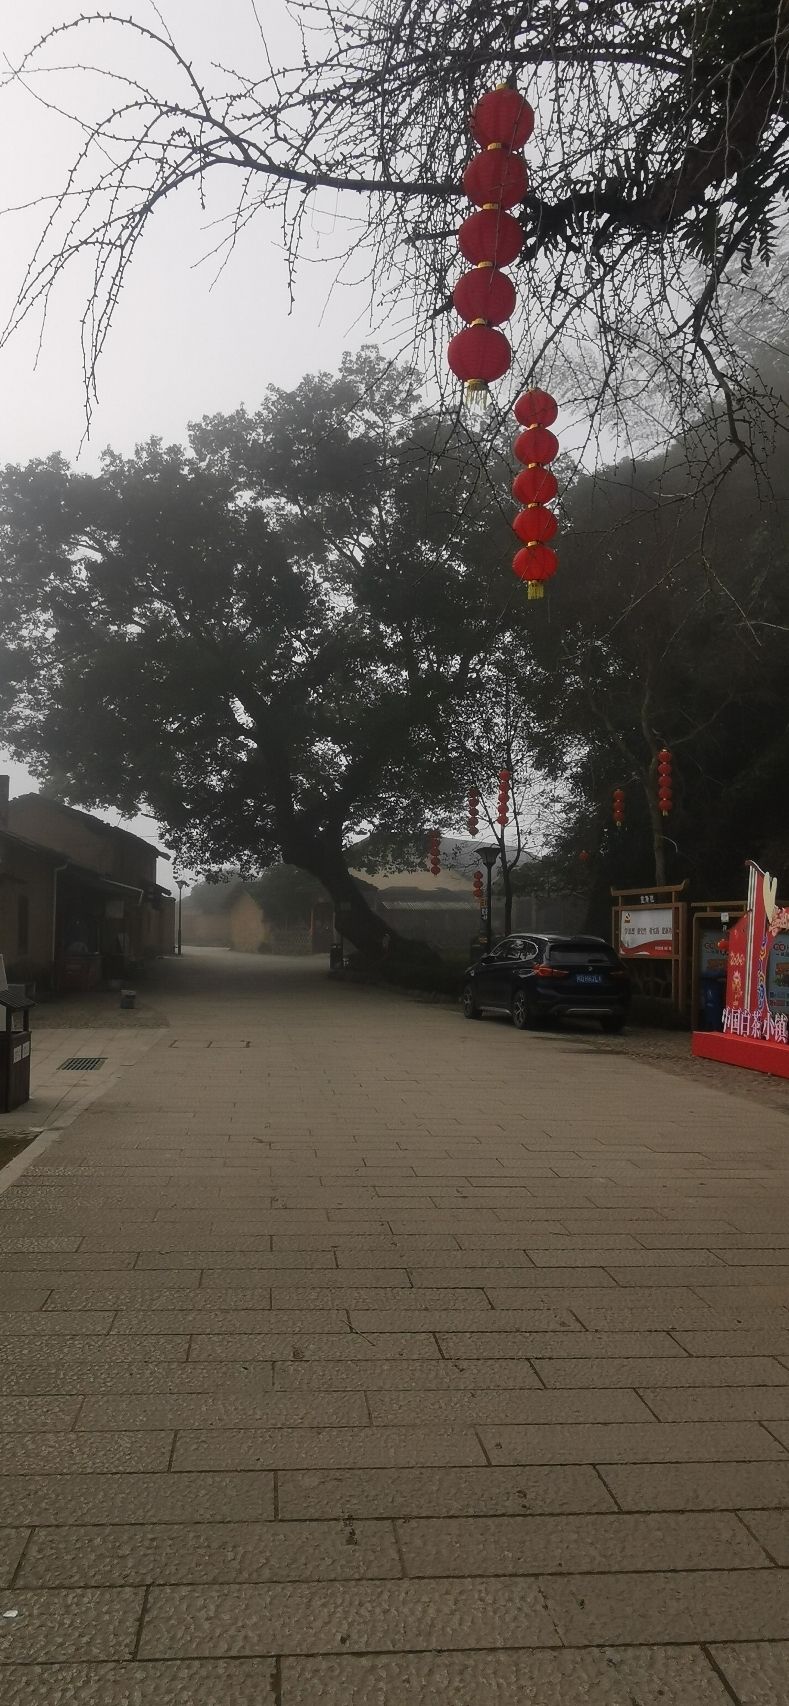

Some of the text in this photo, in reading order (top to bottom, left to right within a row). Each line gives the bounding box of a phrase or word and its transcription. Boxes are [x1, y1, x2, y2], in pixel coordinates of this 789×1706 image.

[721, 1007, 788, 1043] 中国白茶小镇
